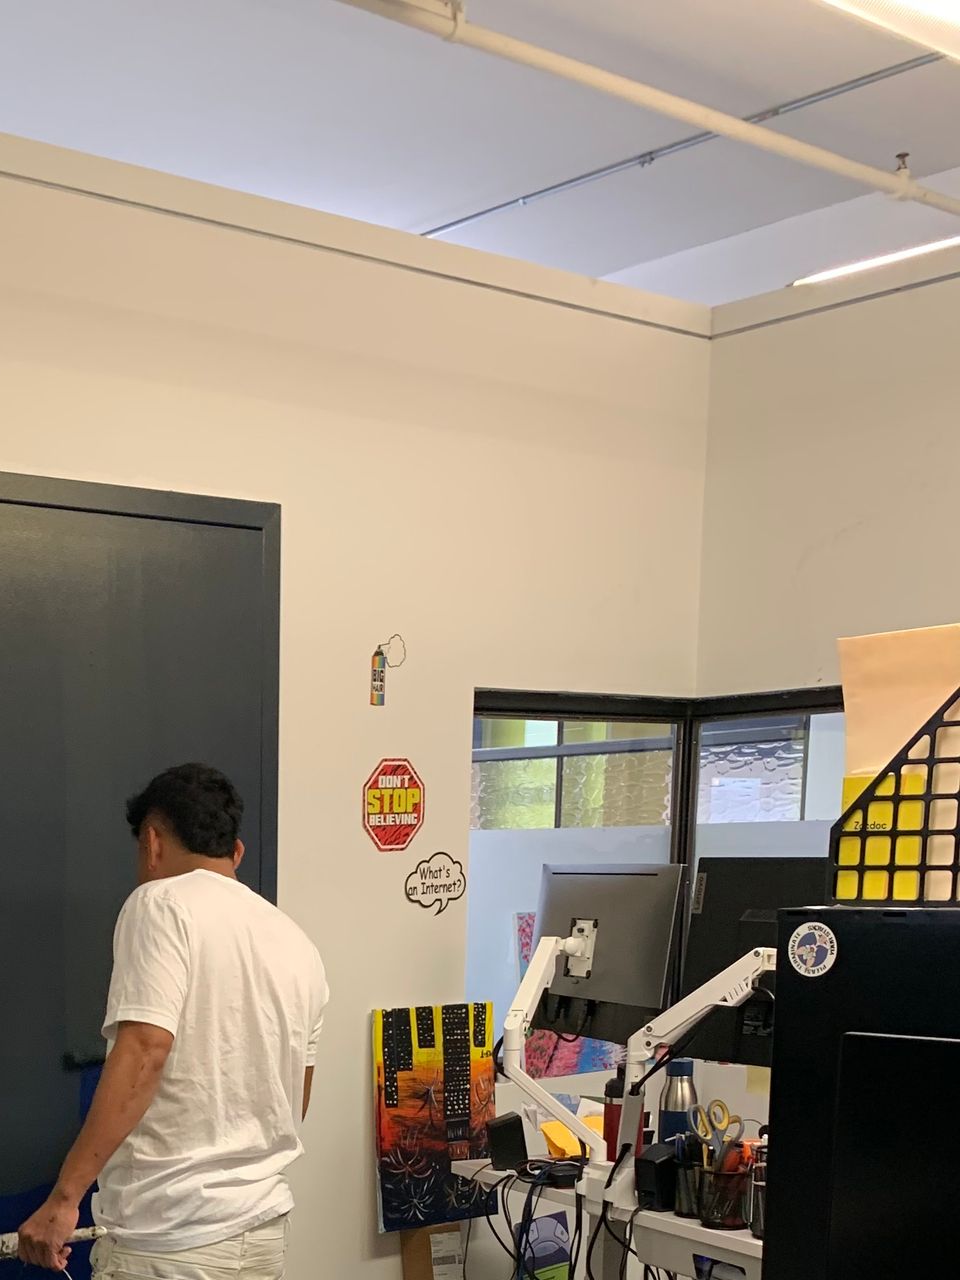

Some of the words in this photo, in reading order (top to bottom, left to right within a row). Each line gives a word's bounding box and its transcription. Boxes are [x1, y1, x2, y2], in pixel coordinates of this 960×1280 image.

[373, 669, 384, 682] BIG
[378, 775, 410, 788] DON'T
[367, 788, 420, 814] STOP
[369, 814, 417, 826] BELIEVING
[419, 865, 451, 881] What's
[407, 885, 418, 896] an
[421, 878, 462, 896] Internet?
